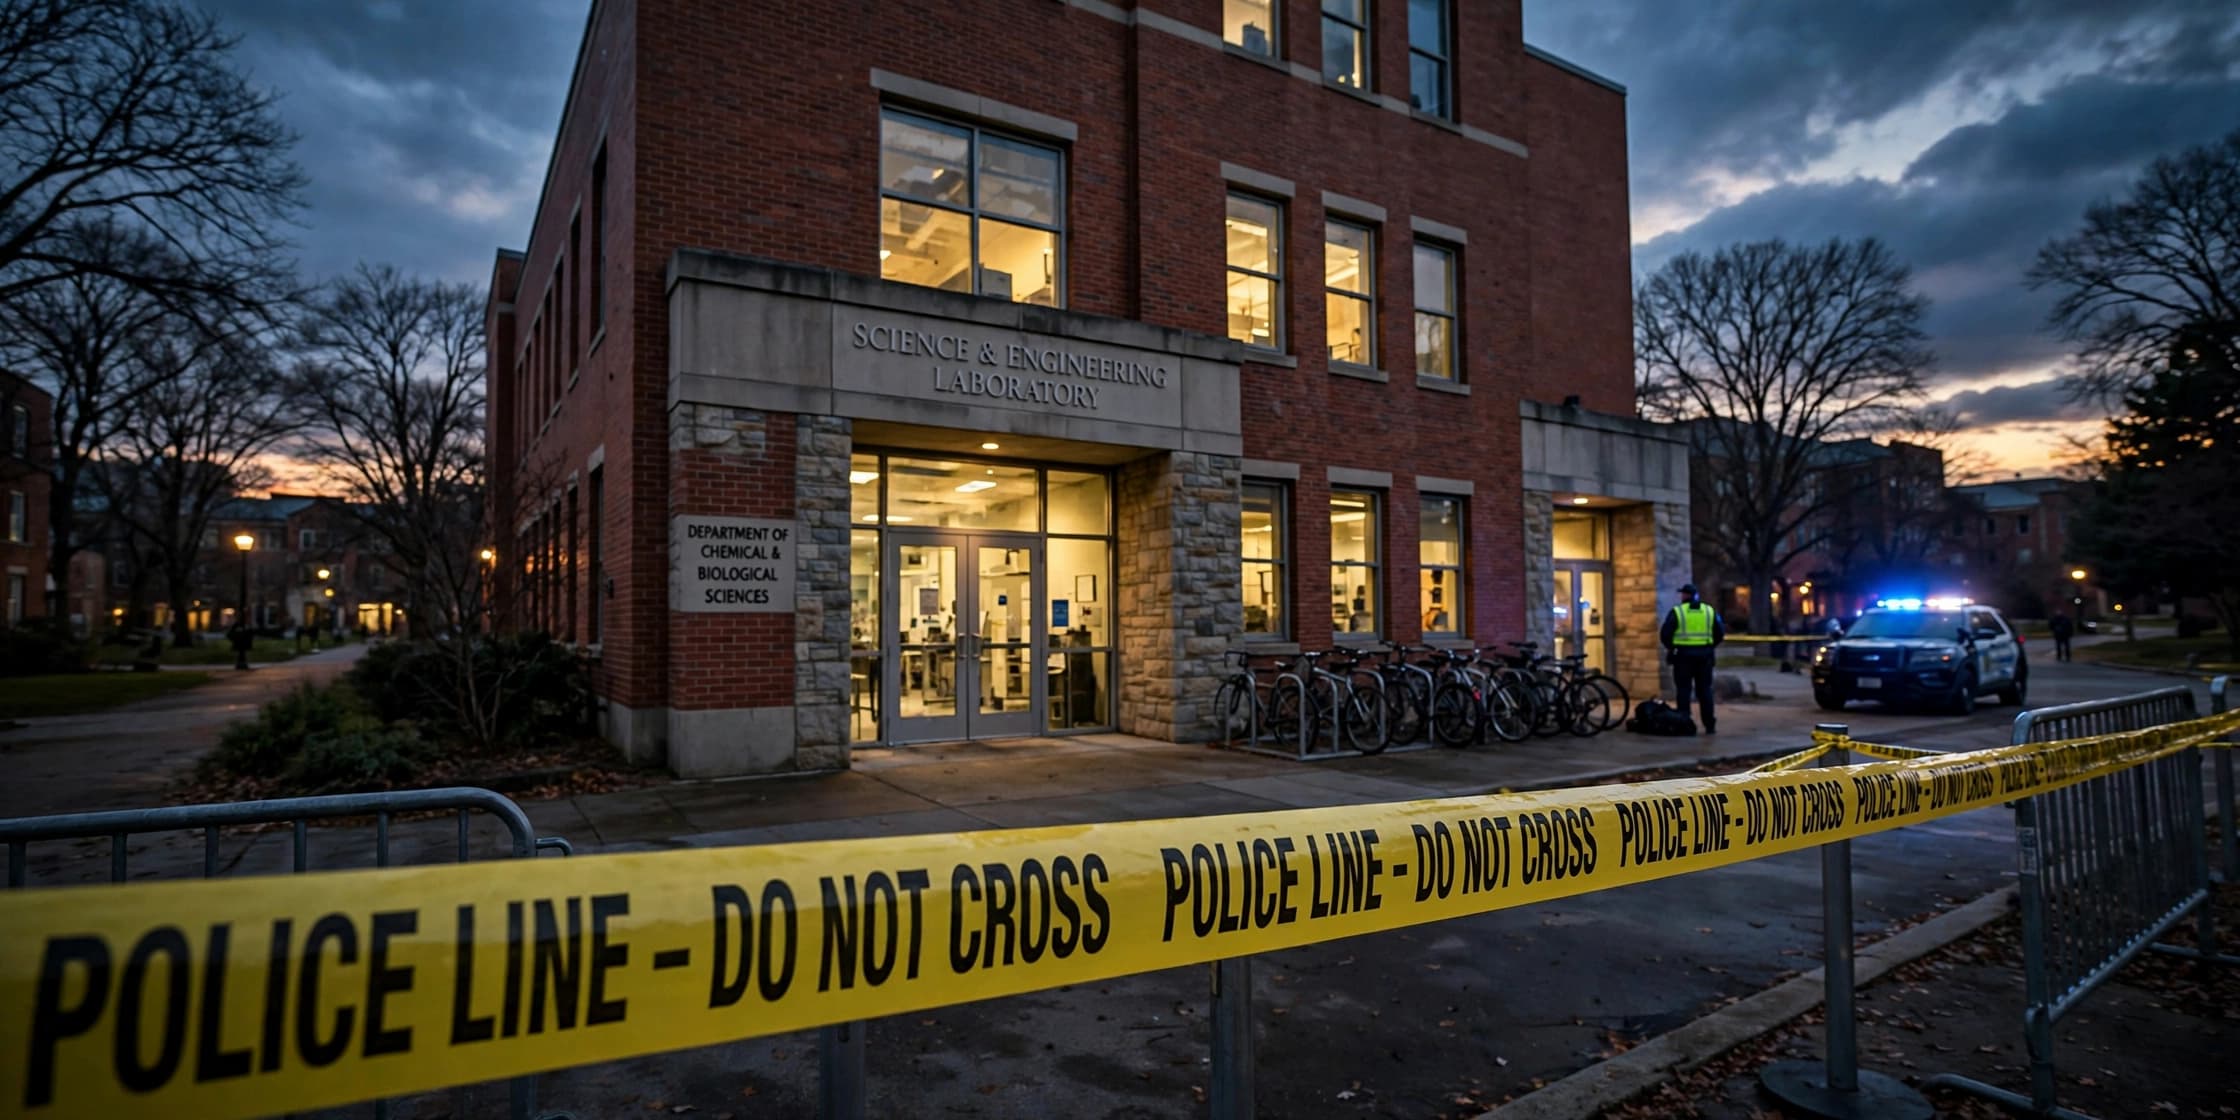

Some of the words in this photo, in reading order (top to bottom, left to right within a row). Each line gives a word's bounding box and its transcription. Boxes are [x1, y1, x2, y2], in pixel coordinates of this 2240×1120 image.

[853, 321, 969, 362] SCIENCE
[978, 341, 998, 365] &
[1007, 344, 1168, 389] ENGINEERING
[934, 366, 1100, 410] LABORATORY
[688, 524, 769, 541] DEPARTMENT
[772, 528, 789, 541] OF
[701, 544, 768, 560] CHEMICAL
[771, 546, 781, 559] &
[698, 566, 778, 581] BIOLOGICAL
[705, 588, 769, 604] SCIENCES
[23, 909, 419, 1111] POLICE
[449, 893, 631, 1048] LINE
[708, 878, 798, 1009] DO
[818, 868, 930, 993] NOT
[949, 853, 1111, 974] CROSS
[1160, 836, 1298, 942] POLICE
[1307, 829, 1383, 919] LINE
[1410, 820, 1455, 902] DO
[1458, 816, 1512, 895] NOT
[1519, 806, 1598, 885] CROSS
[1615, 797, 1688, 867] POLICE
[1688, 793, 1730, 855] LINE
[1743, 789, 1768, 845] DO
[1768, 785, 1798, 841] NOT
[1800, 780, 1844, 835] CROSS
[1853, 773, 1896, 825] POLICE
